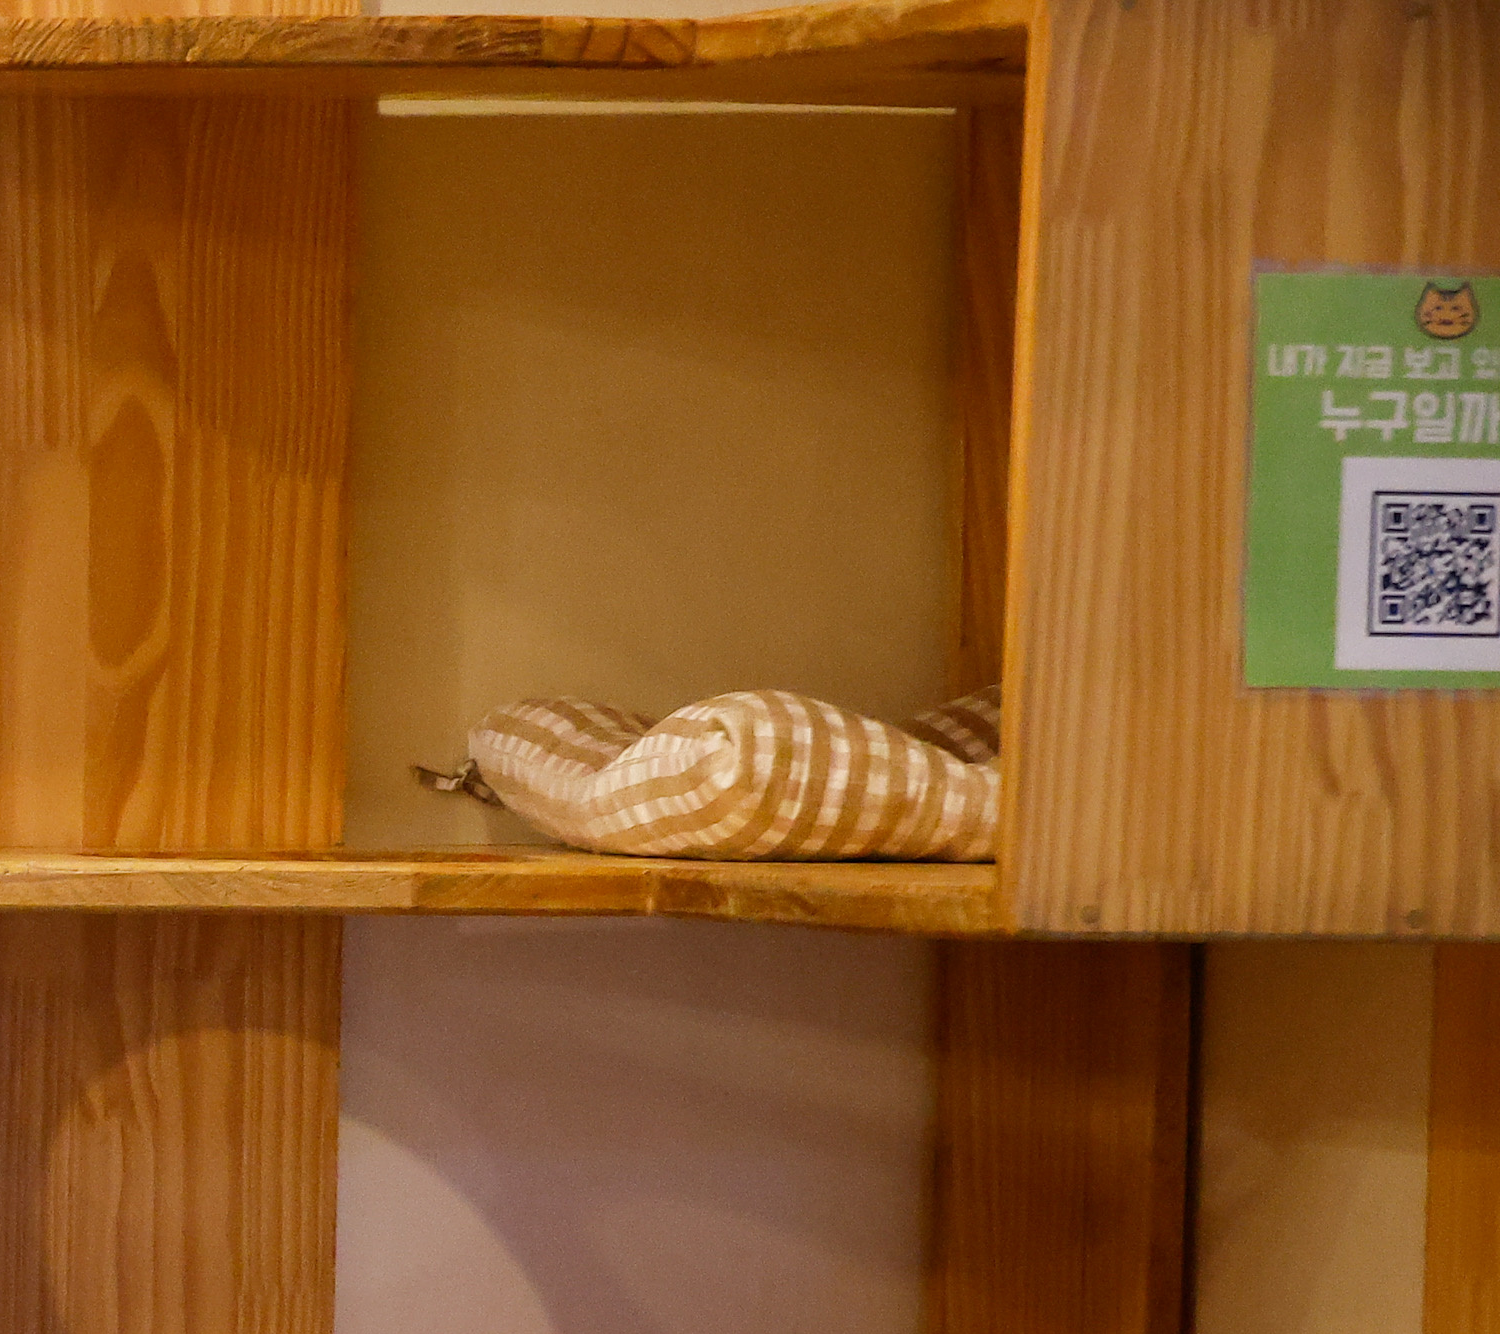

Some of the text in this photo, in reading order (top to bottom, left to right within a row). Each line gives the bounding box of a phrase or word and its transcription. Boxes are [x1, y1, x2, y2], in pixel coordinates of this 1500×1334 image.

[1267, 344, 1327, 378] 내가
[1335, 345, 1393, 379] 지금
[1404, 346, 1461, 380] 보고
